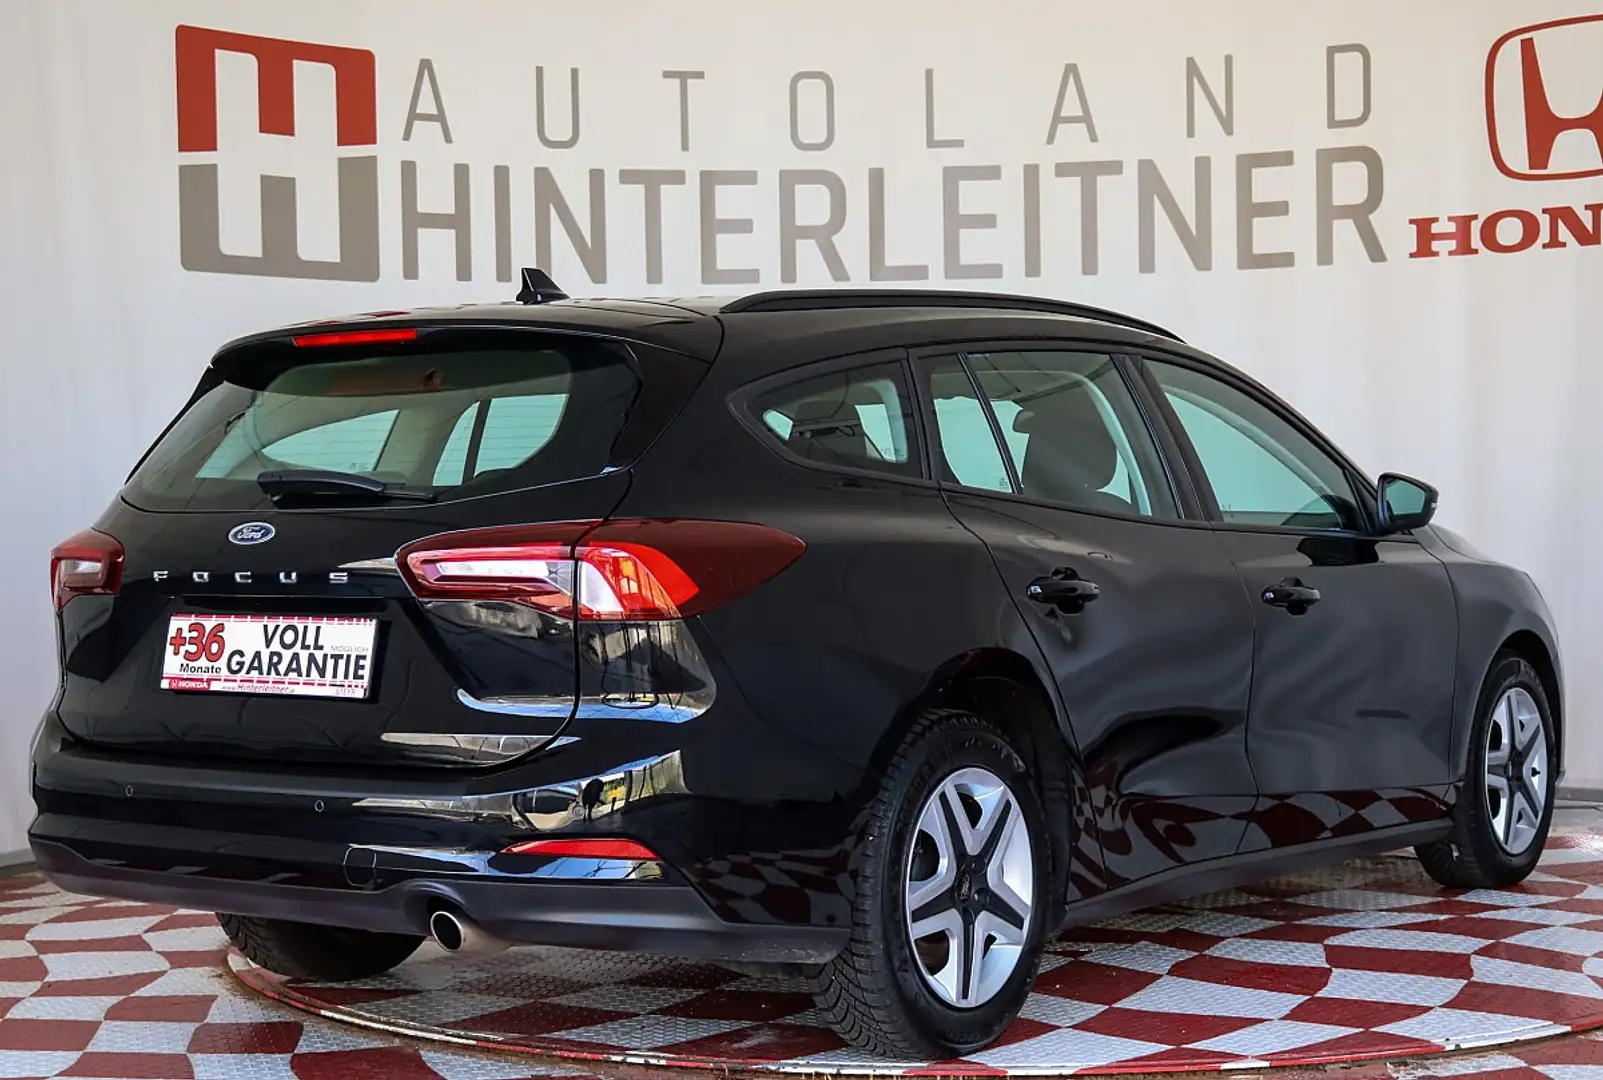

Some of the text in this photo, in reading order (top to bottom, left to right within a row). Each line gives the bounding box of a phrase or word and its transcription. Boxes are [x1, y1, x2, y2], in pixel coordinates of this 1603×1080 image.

[401, 43, 1372, 152] AUTOLAND
[401, 146, 1387, 285] HINTERLEITNER
[236, 526, 266, 539] Ford
[153, 570, 349, 584] FOCUS
[169, 622, 226, 663] +36
[263, 624, 325, 651] VOLL
[179, 663, 222, 674] Monate
[226, 649, 367, 680] GARANTIE
[177, 680, 209, 689] HONDA
